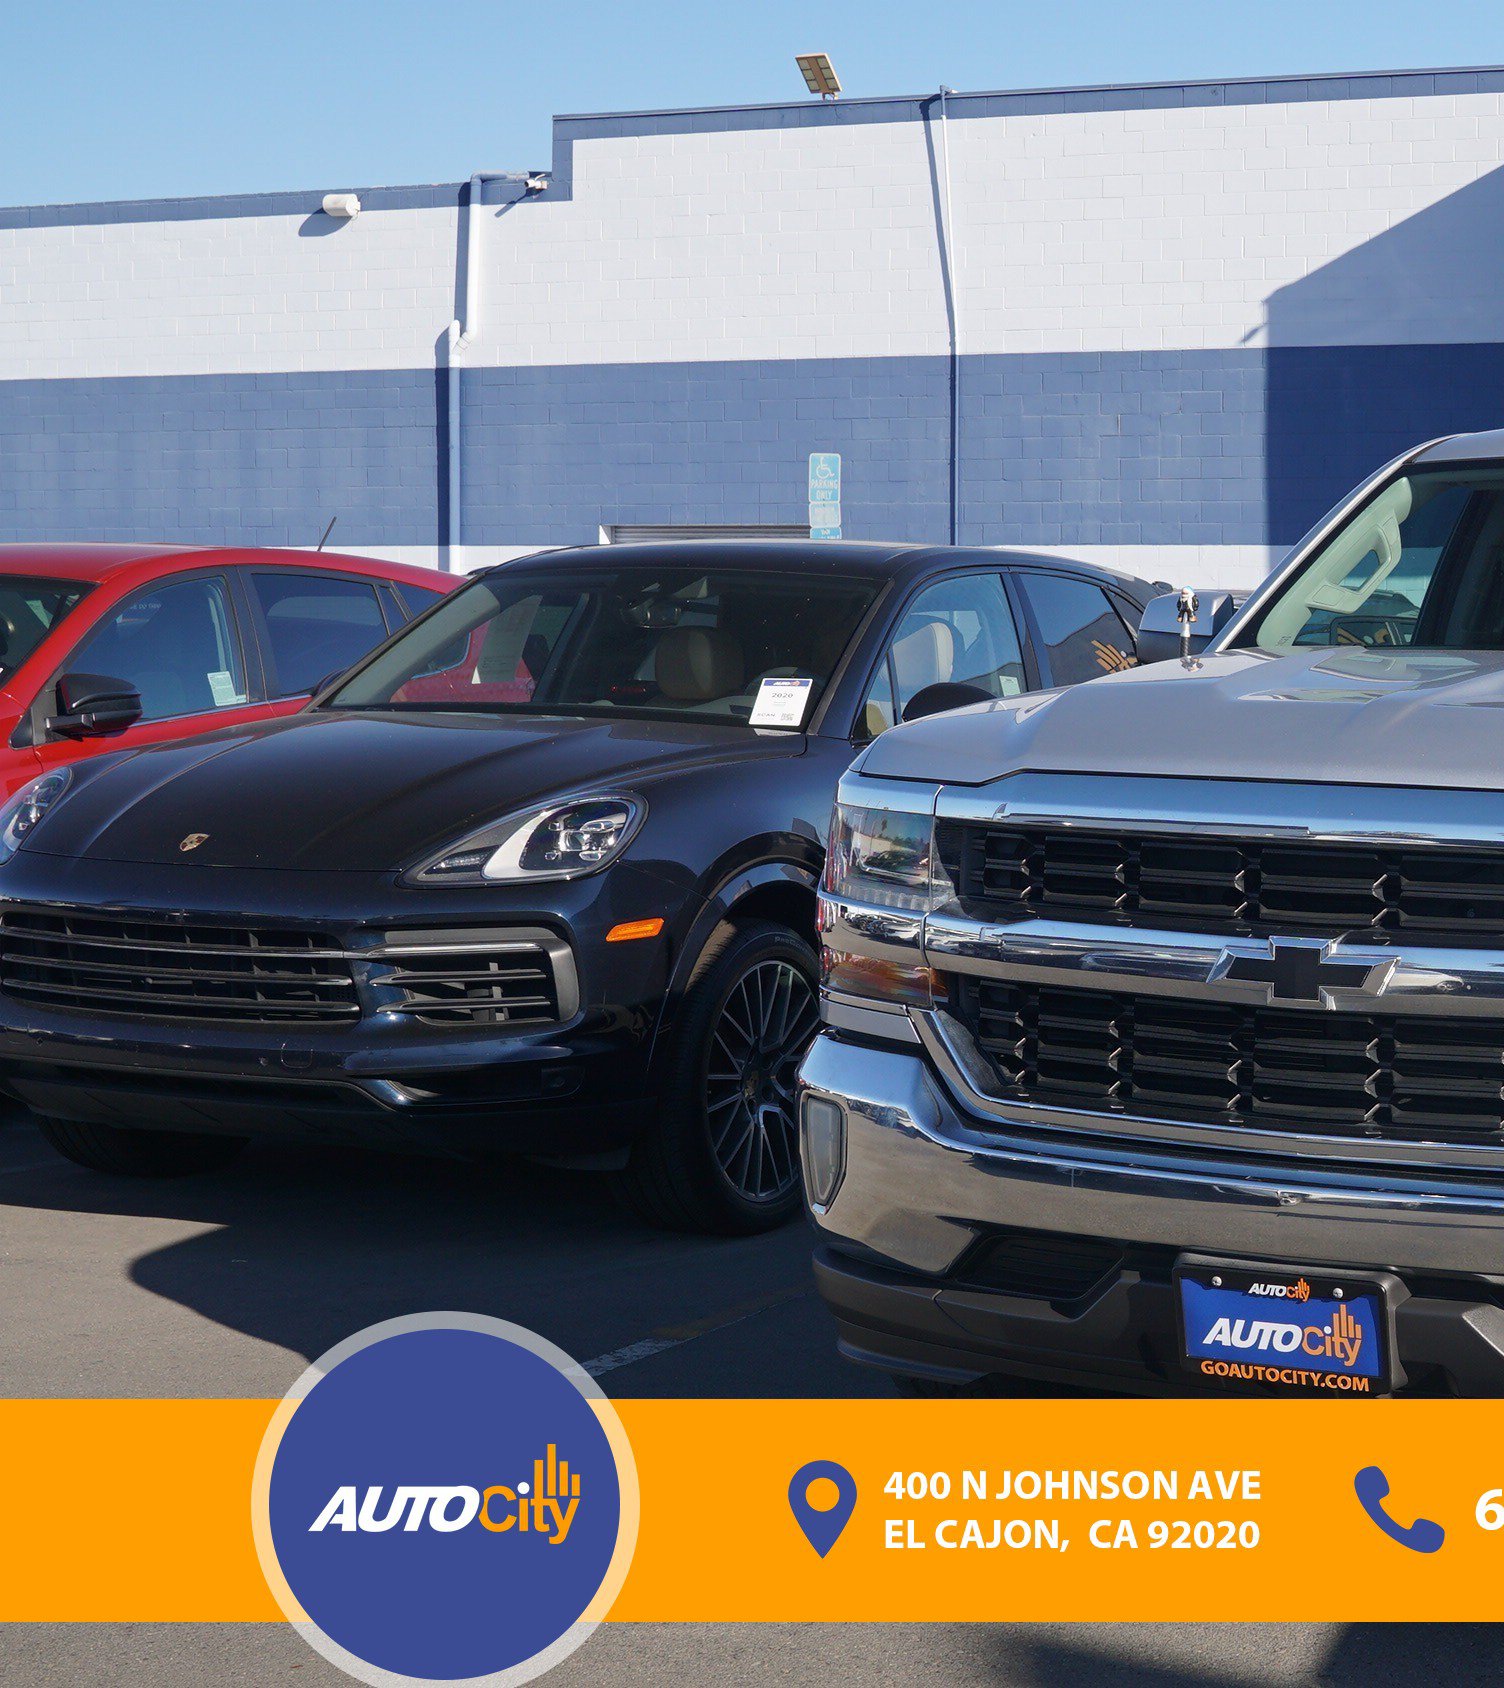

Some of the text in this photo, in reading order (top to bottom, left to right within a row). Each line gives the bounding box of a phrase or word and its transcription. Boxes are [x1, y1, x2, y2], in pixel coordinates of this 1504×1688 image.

[810, 479, 838, 490] PARKING
[816, 490, 833, 500] ONLY
[1248, 1279, 1310, 1302] AUTOCity
[1202, 1311, 1362, 1367] AUTOCity
[1200, 1360, 1370, 1392] GOAUTOCITY.COM
